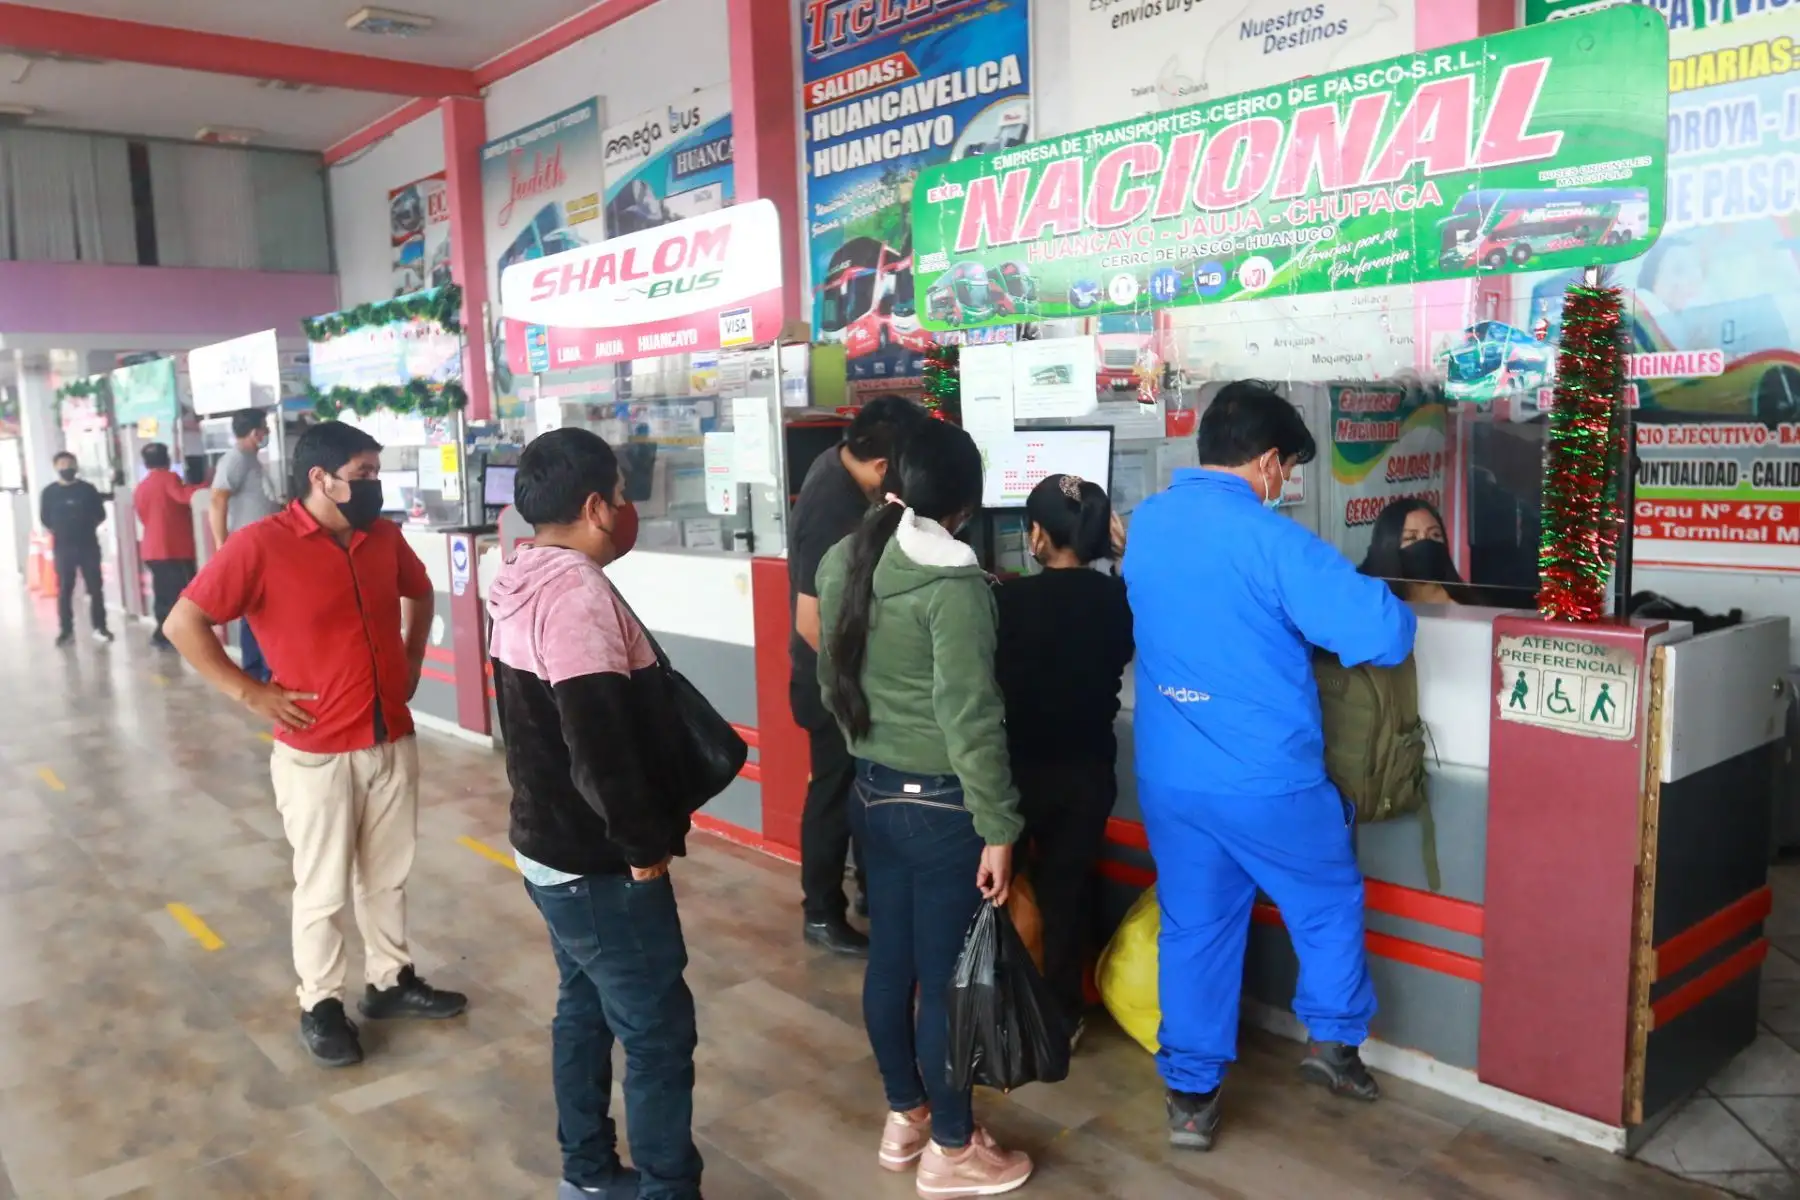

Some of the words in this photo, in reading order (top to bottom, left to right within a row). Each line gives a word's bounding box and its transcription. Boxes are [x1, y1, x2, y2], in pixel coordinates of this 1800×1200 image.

[1240, 2, 1325, 40] Nuestros
[1263, 17, 1349, 55] Destinos
[811, 58, 904, 104] SALIDAS:
[812, 54, 1022, 141] HUANCAVELICA
[668, 105, 701, 134] bus
[994, 144, 1058, 171] EMPRESA
[1061, 137, 1082, 154] DE
[1209, 92, 1282, 122] CERRO
[1288, 80, 1317, 106] DE
[1323, 66, 1403, 97] PASCO
[813, 114, 954, 178] HUANCAYO
[956, 57, 1564, 254] NACIONAL
[1702, 158, 1800, 220] PASC
[1028, 226, 1152, 264] HUANCAYO
[1175, 208, 1262, 241] JAUJA
[1288, 181, 1443, 225] CHUPACA
[530, 222, 732, 301] SHALOM
[1101, 250, 1149, 269] CERRO
[1156, 248, 1174, 260] DE
[1179, 240, 1233, 258] PASCO
[1247, 225, 1336, 250] HUANUCO
[648, 269, 723, 299] BUS
[637, 329, 698, 352] HUANCAYO
[725, 317, 747, 333] VISA
[1312, 353, 1364, 366] Moquegua
[1668, 427, 1767, 445] EJECUTIVO
[1635, 502, 1693, 519] Grau
[1737, 506, 1784, 521] 476
[1660, 524, 1768, 541] Terminal
[1501, 648, 1628, 676] PREFERENCIAL
[1521, 636, 1606, 656] ATENCION
